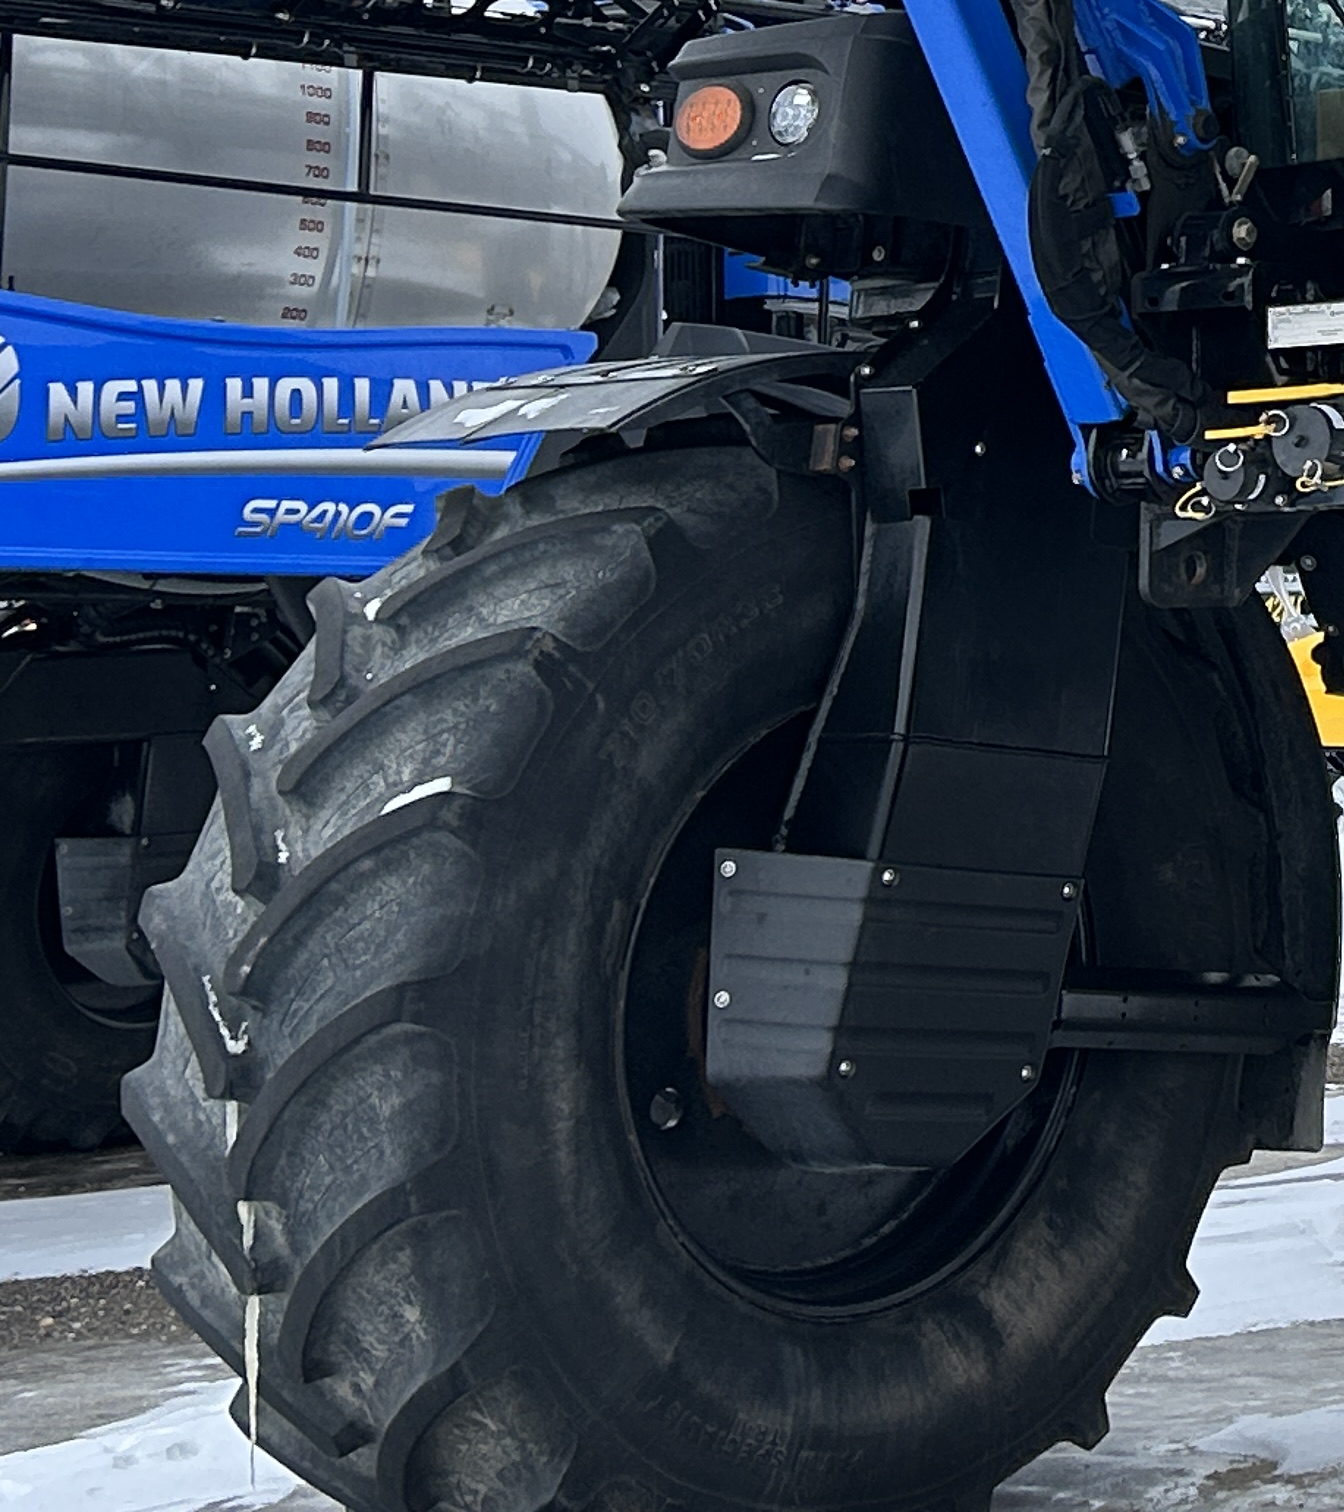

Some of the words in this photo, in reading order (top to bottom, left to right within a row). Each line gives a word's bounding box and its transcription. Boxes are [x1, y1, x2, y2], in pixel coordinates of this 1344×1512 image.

[299, 84, 332, 100] 1000
[304, 164, 330, 180] 700
[298, 218, 325, 233] 500
[293, 245, 320, 260] 400
[288, 272, 316, 287] 300
[281, 306, 308, 321] 200
[46, 376, 204, 442] NEW
[225, 376, 497, 436] HOLLAN
[234, 497, 415, 541] SP410F
